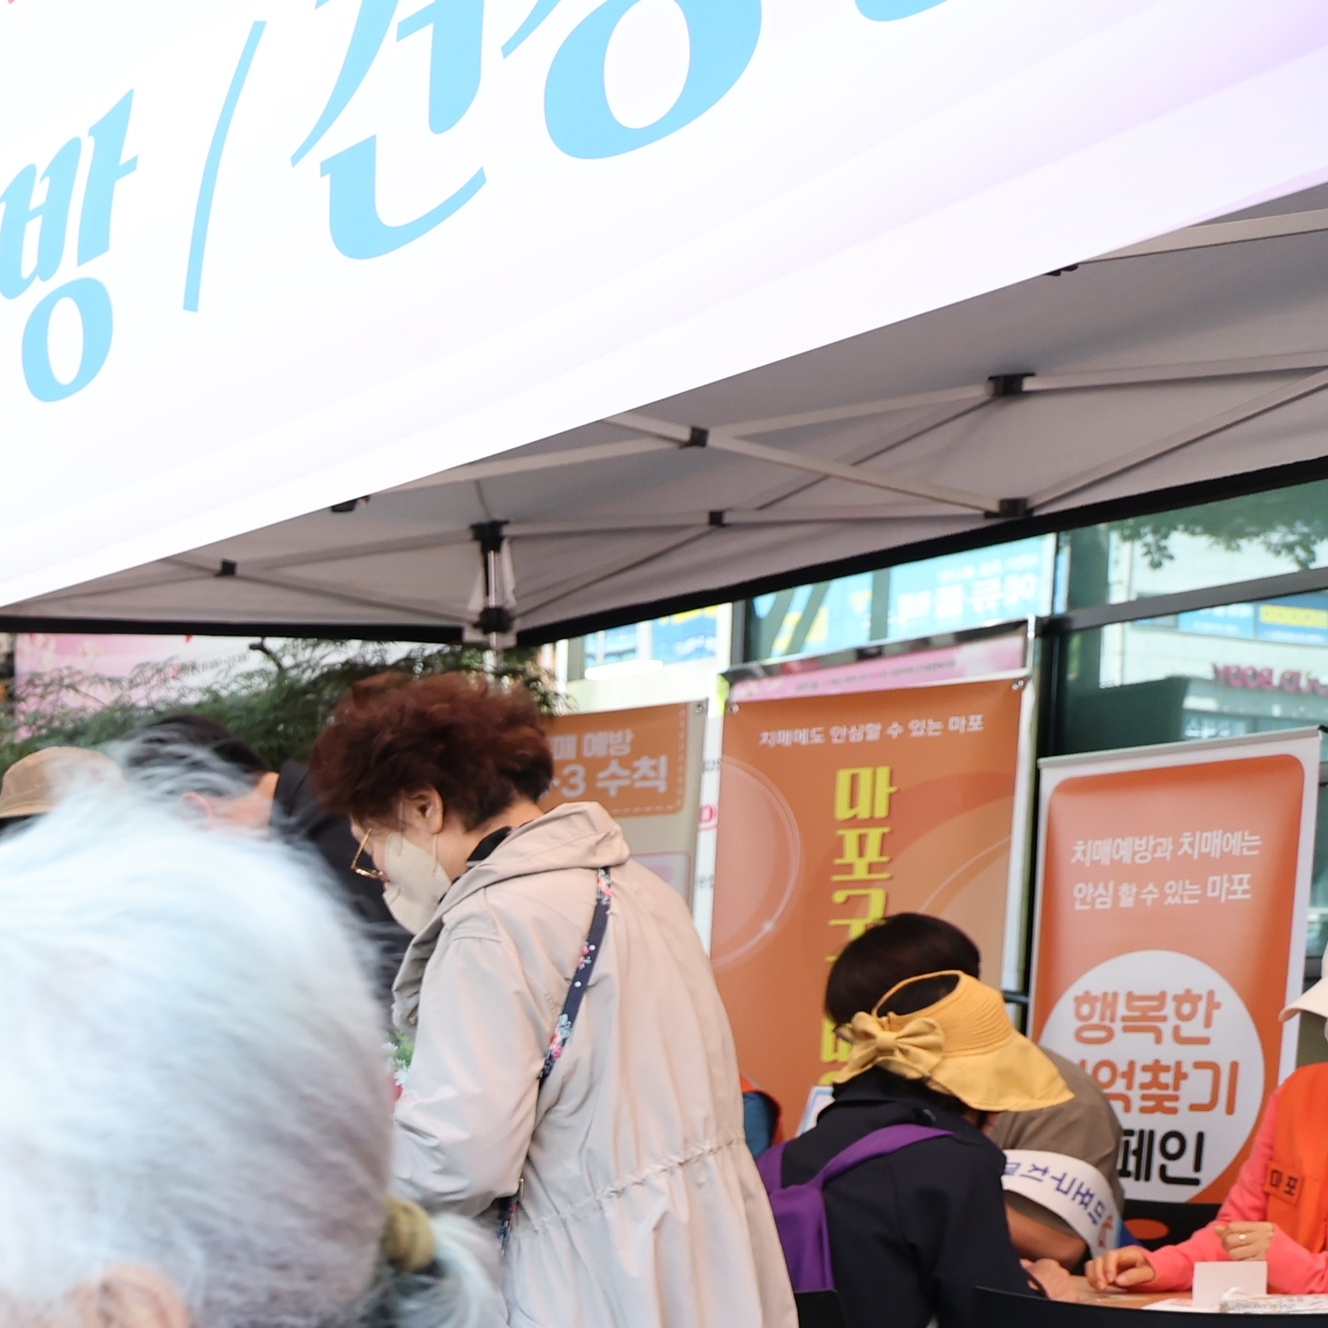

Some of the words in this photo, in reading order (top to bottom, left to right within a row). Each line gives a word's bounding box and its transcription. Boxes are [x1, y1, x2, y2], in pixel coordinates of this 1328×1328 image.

[550, 733, 578, 761] 매
[583, 728, 635, 757] 예방
[759, 726, 826, 748] 치매에도
[829, 722, 883, 745] 안심할
[886, 721, 905, 739] 수
[908, 717, 945, 739] 있는
[947, 713, 985, 735] 마포
[596, 755, 669, 798] 수칙
[1070, 835, 1174, 868] 치매예방과
[1177, 828, 1263, 860] 치매에는
[1163, 879, 1202, 906] 있는
[1206, 873, 1253, 904] 마포
[1073, 988, 1222, 1046] 행복한
